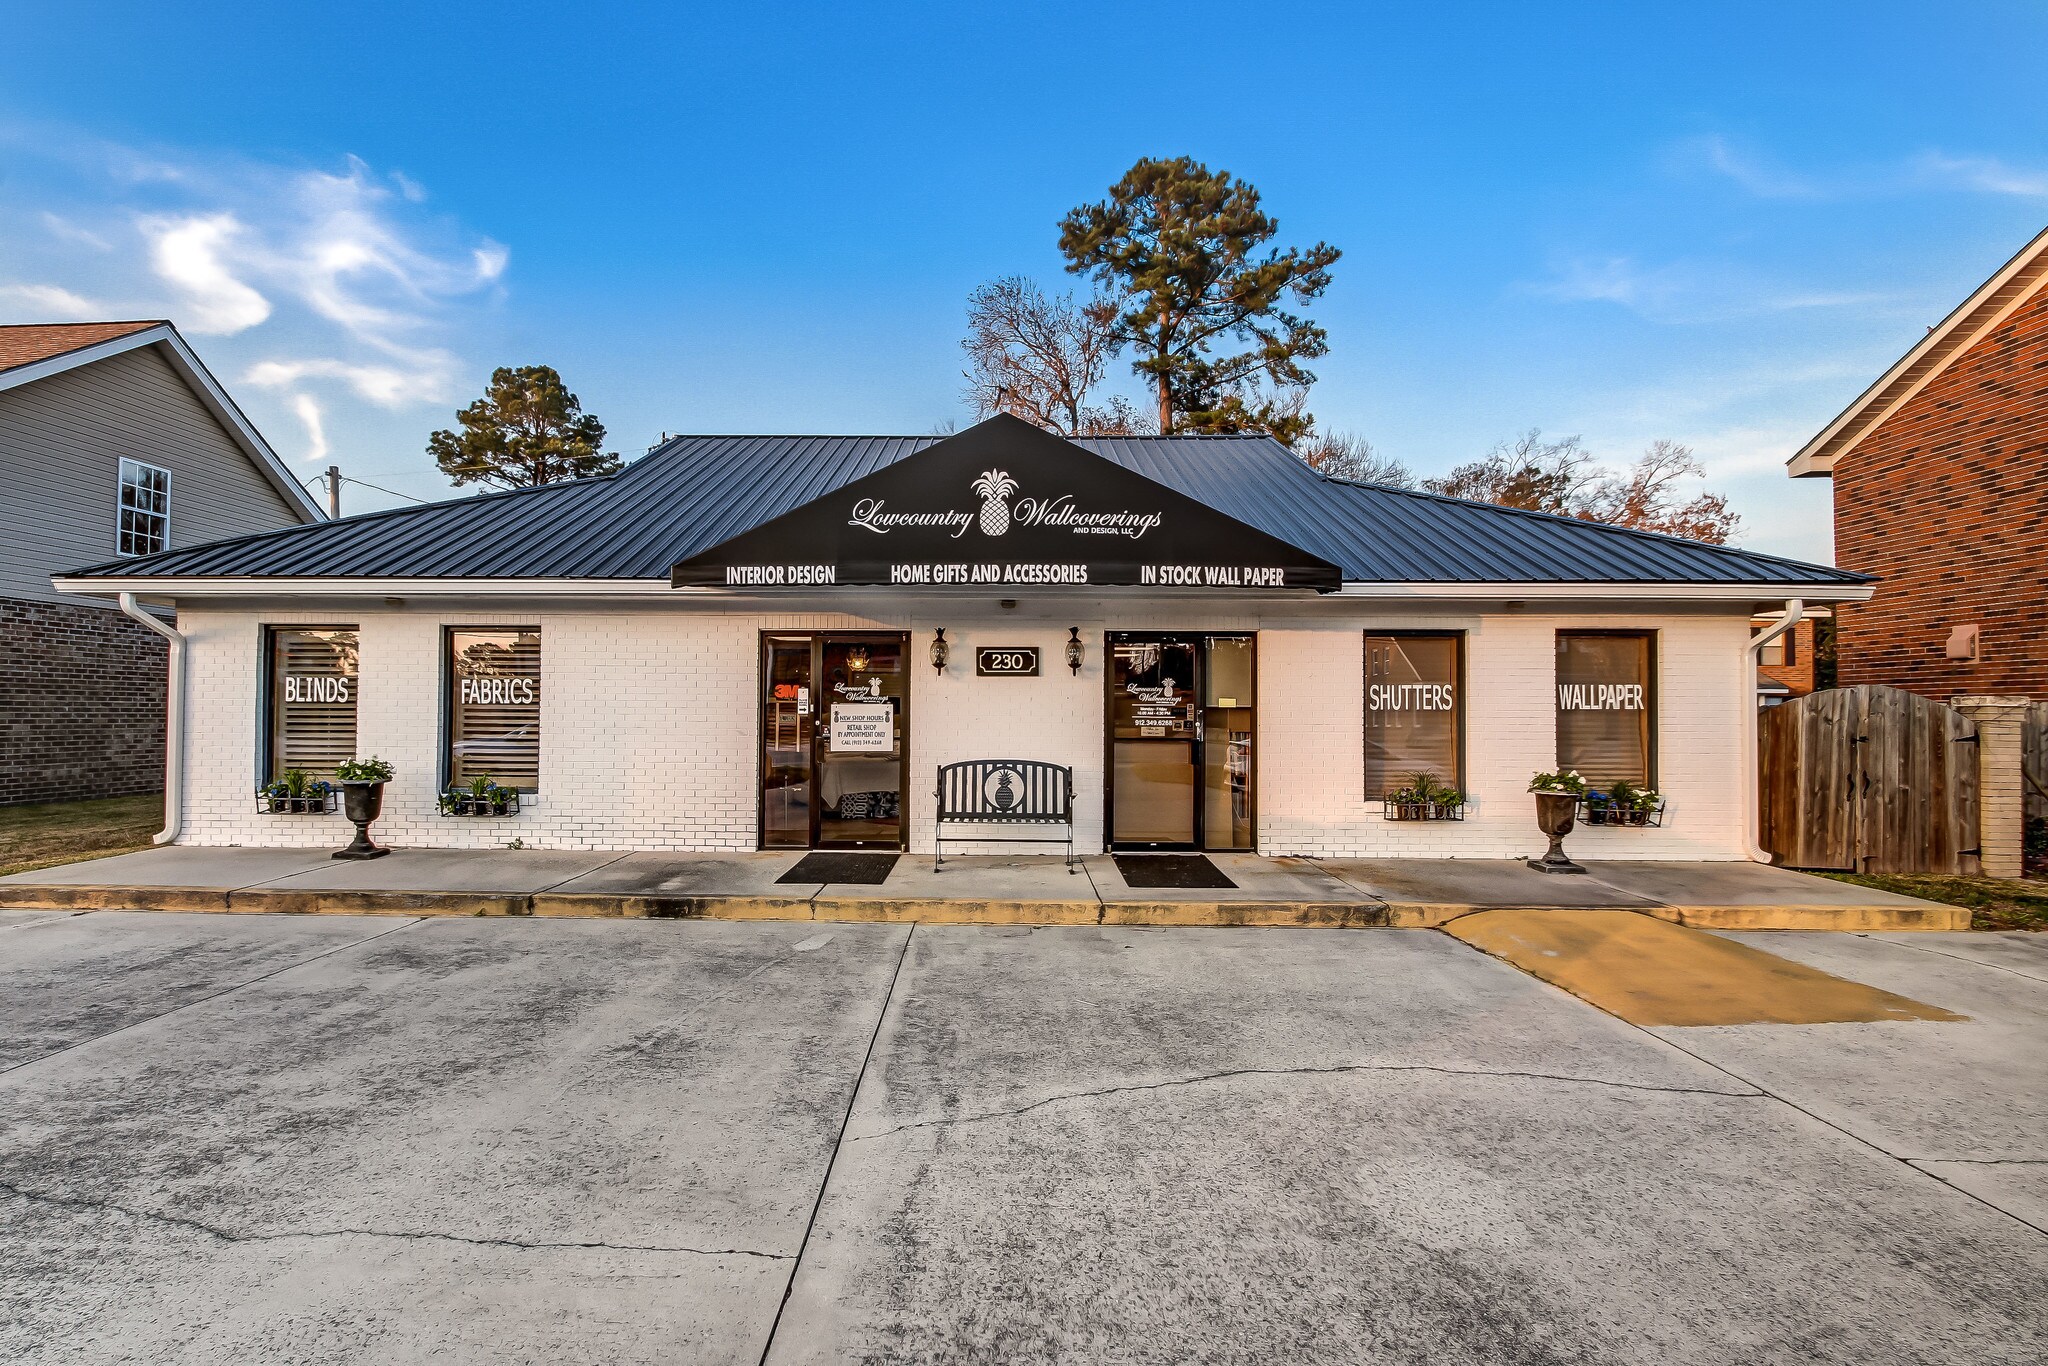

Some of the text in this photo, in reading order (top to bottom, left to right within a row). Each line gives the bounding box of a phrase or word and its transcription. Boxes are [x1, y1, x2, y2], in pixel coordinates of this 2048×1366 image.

[848, 494, 1162, 539] Lowcountry Wallcoverings
[1091, 527, 1119, 535] DESIGN,
[726, 565, 836, 584] INTERIOR DESIGN
[891, 564, 1088, 583] HOME GIFTS AND ACCESSORIES
[1141, 565, 1285, 586] IN STOCK WALL PAPER
[991, 654, 1024, 669] 230
[285, 676, 349, 703] BLINDS
[461, 678, 534, 704] FABRICS
[774, 684, 799, 698] 3M
[1369, 684, 1453, 711] SHUTTERS
[1558, 684, 1644, 710] WALLPAPER
